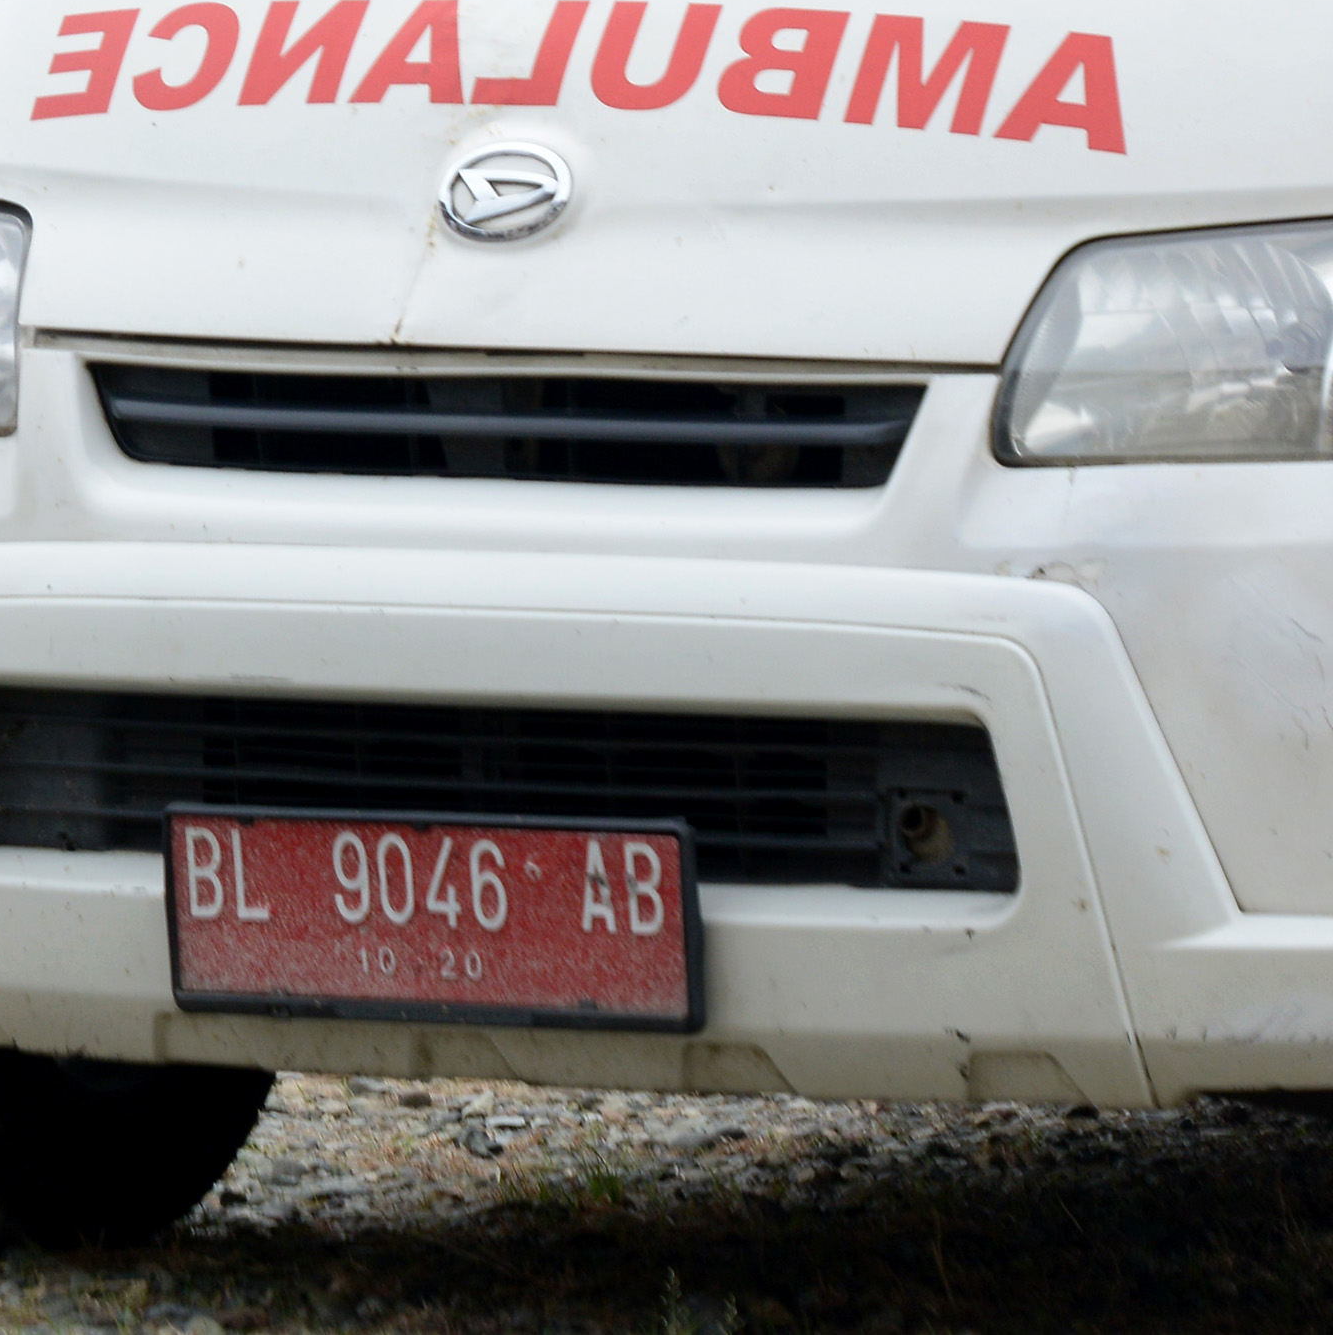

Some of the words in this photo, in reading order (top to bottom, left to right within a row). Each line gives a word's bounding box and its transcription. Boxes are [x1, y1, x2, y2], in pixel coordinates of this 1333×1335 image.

[184, 826, 271, 922] BL
[332, 831, 508, 932] 9046
[581, 839, 664, 935] AB
[358, 945, 396, 976] 10
[439, 948, 483, 982] 20
